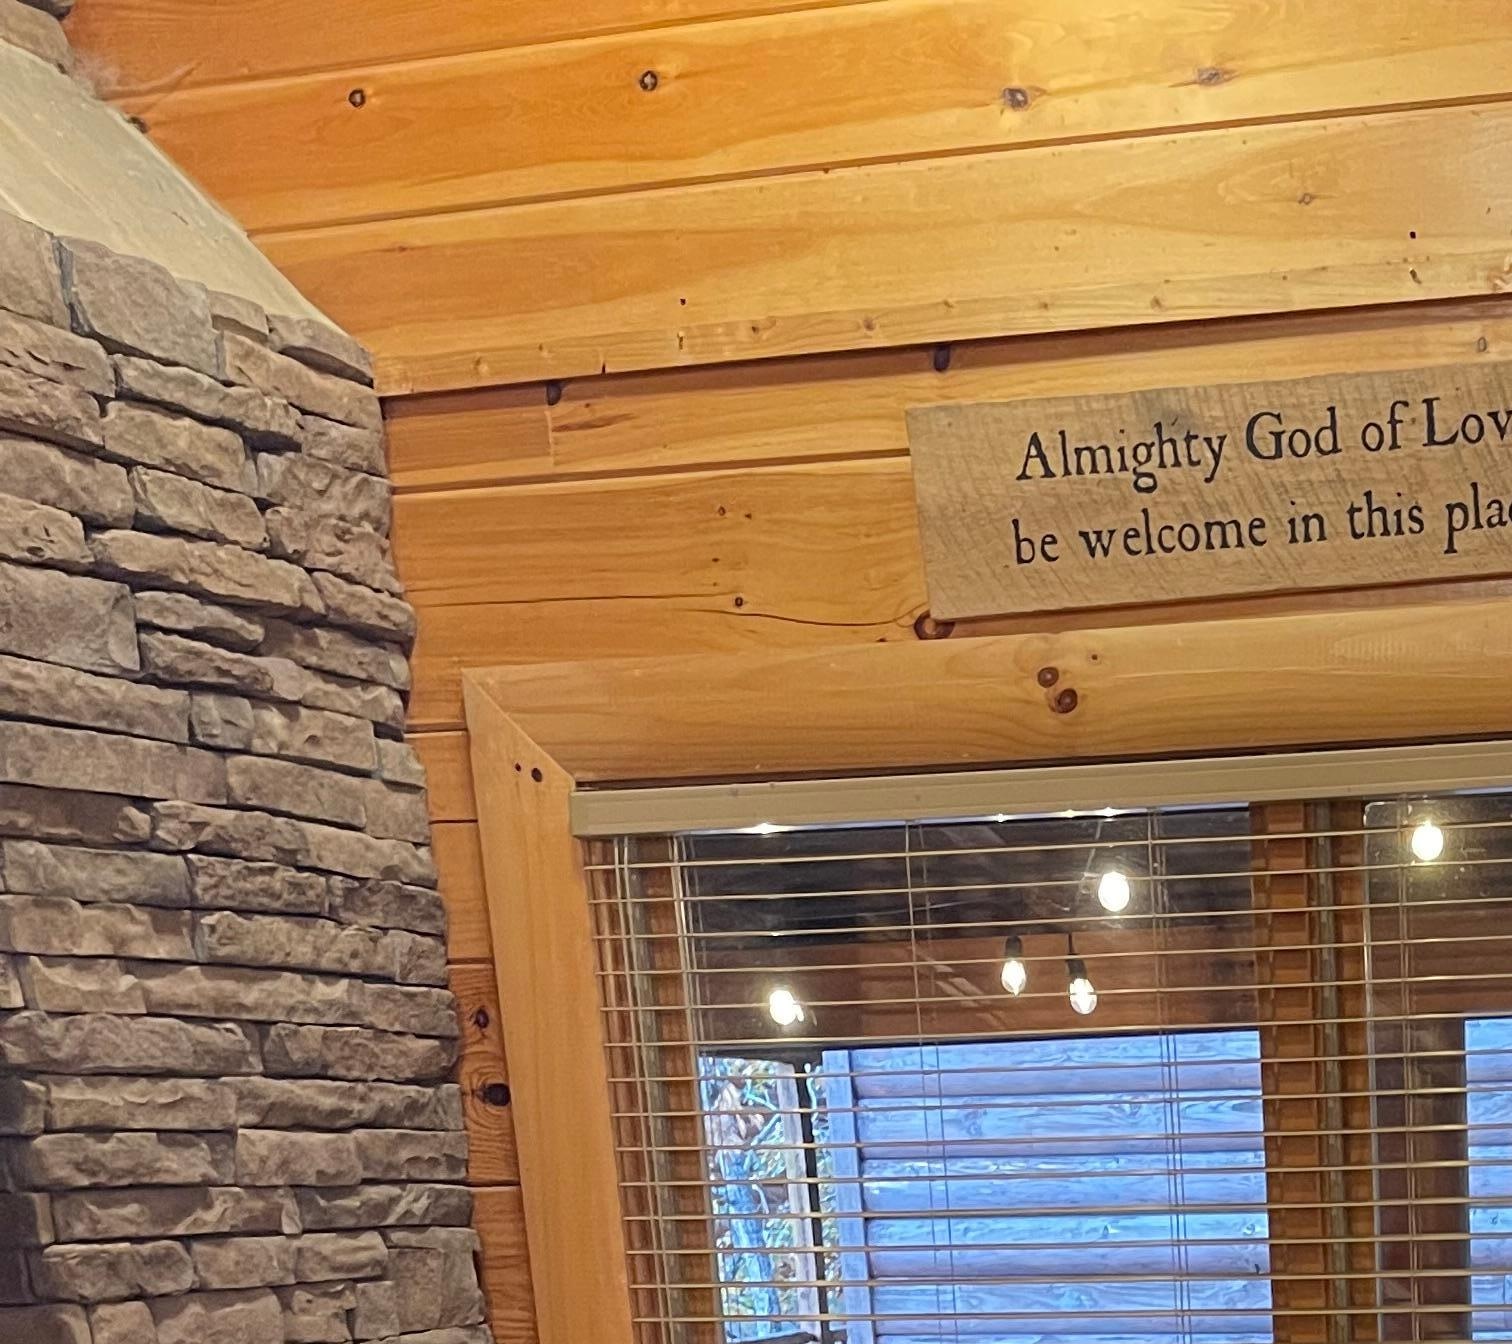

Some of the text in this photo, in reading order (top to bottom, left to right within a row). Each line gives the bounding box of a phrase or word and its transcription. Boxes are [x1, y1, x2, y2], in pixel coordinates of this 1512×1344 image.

[1015, 420, 1228, 493] Almighty
[1245, 405, 1343, 461] God
[1360, 400, 1410, 452] of
[1011, 518, 1060, 565] be
[1078, 507, 1268, 559] welcome
[1287, 499, 1328, 544] in
[1346, 489, 1426, 540] this
